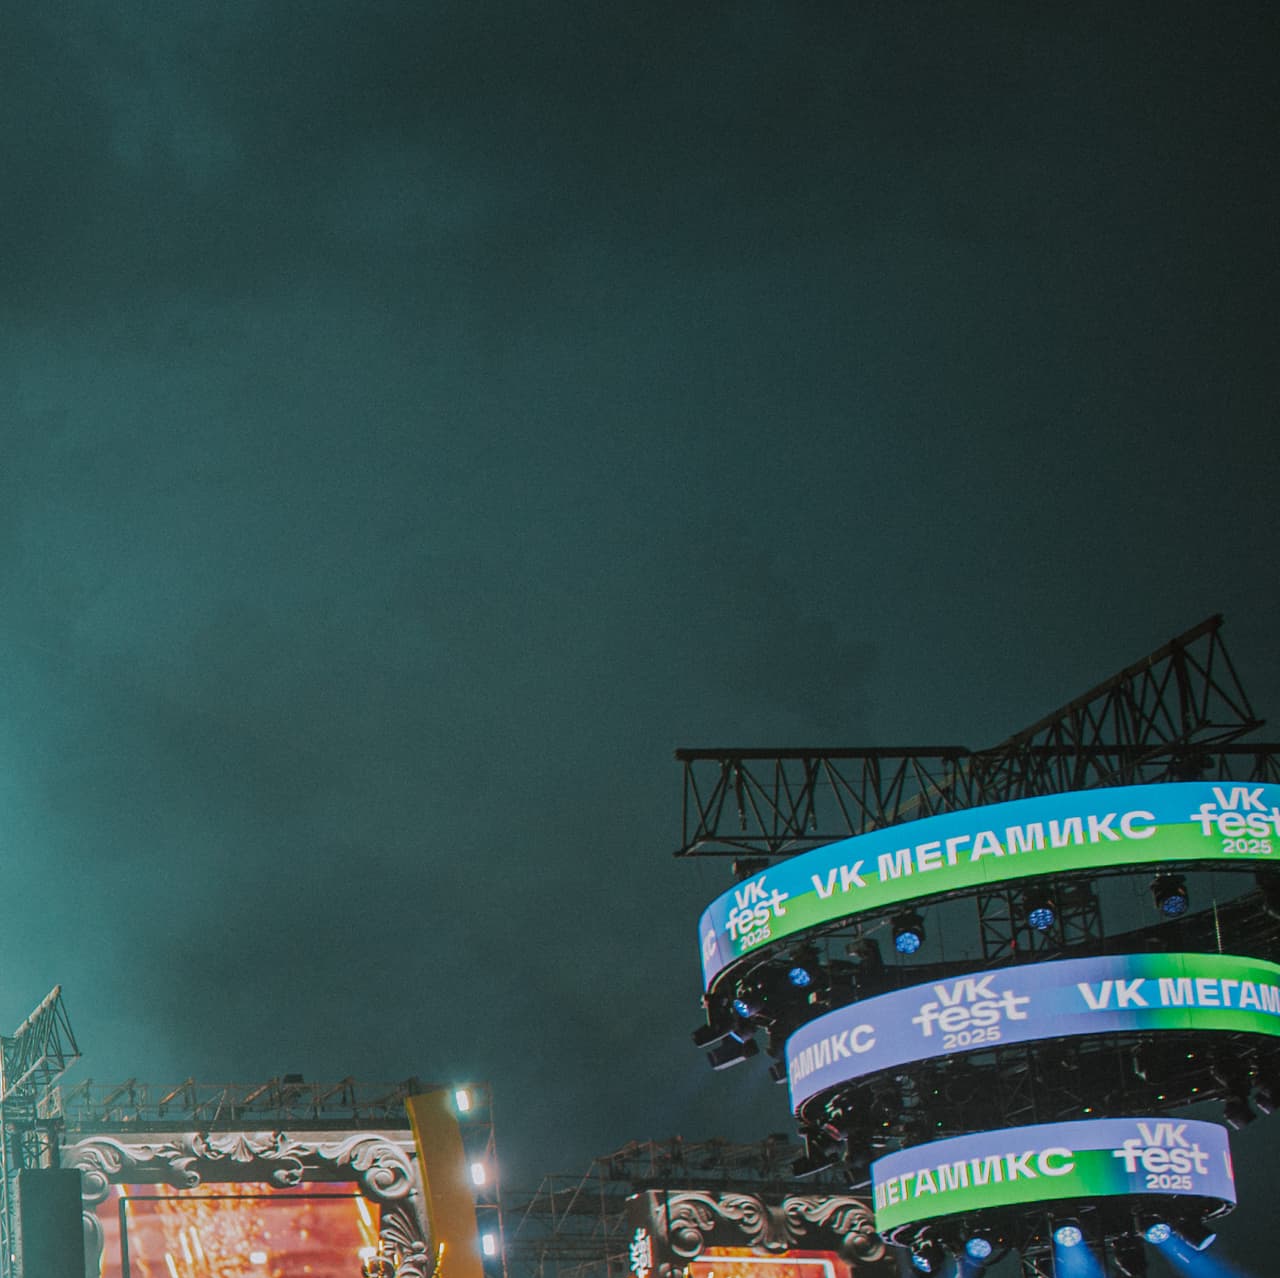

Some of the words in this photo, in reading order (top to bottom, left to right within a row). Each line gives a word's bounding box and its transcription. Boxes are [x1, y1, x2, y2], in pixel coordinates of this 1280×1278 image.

[1213, 787, 1266, 811] VK
[1190, 803, 1280, 838] fest
[811, 860, 867, 899] VK
[877, 810, 1157, 882] МЕГАМИКС
[1223, 839, 1272, 855] 2025
[735, 875, 769, 911] VK
[726, 888, 789, 941] fest
[740, 926, 772, 951] 2025
[934, 975, 999, 1007] VK
[1077, 978, 1149, 1010] VK
[912, 990, 1030, 1037] fest
[943, 1026, 1002, 1050] 2025
[1136, 1122, 1189, 1148] VK
[1113, 1138, 1209, 1175] fest
[1146, 1174, 1192, 1191] 2025
